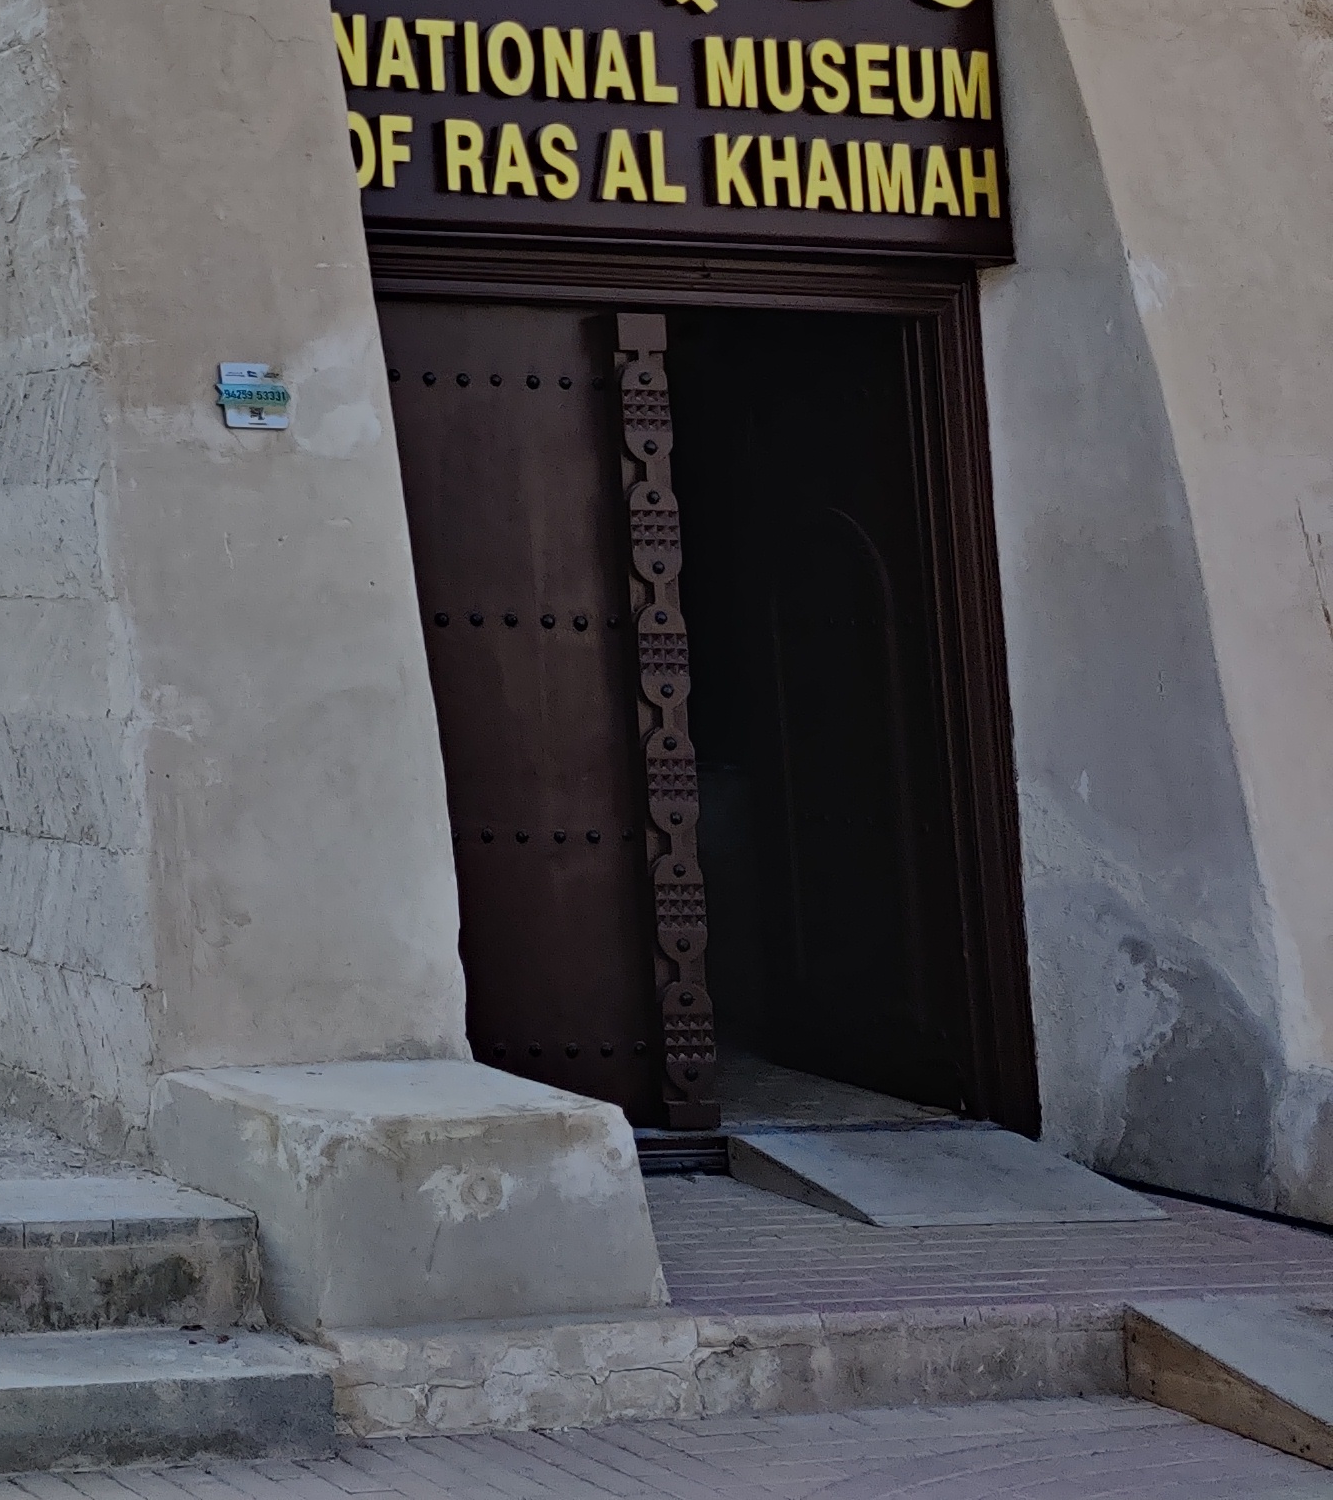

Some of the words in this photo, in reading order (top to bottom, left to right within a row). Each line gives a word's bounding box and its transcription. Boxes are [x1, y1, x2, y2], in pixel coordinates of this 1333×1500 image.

[331, 12, 679, 104] NATIONAL
[704, 35, 992, 120] MUSEUM
[347, 110, 413, 188] OF
[443, 118, 580, 201] RAS
[602, 128, 687, 204] AL
[714, 133, 1001, 218] KHAIMAH
